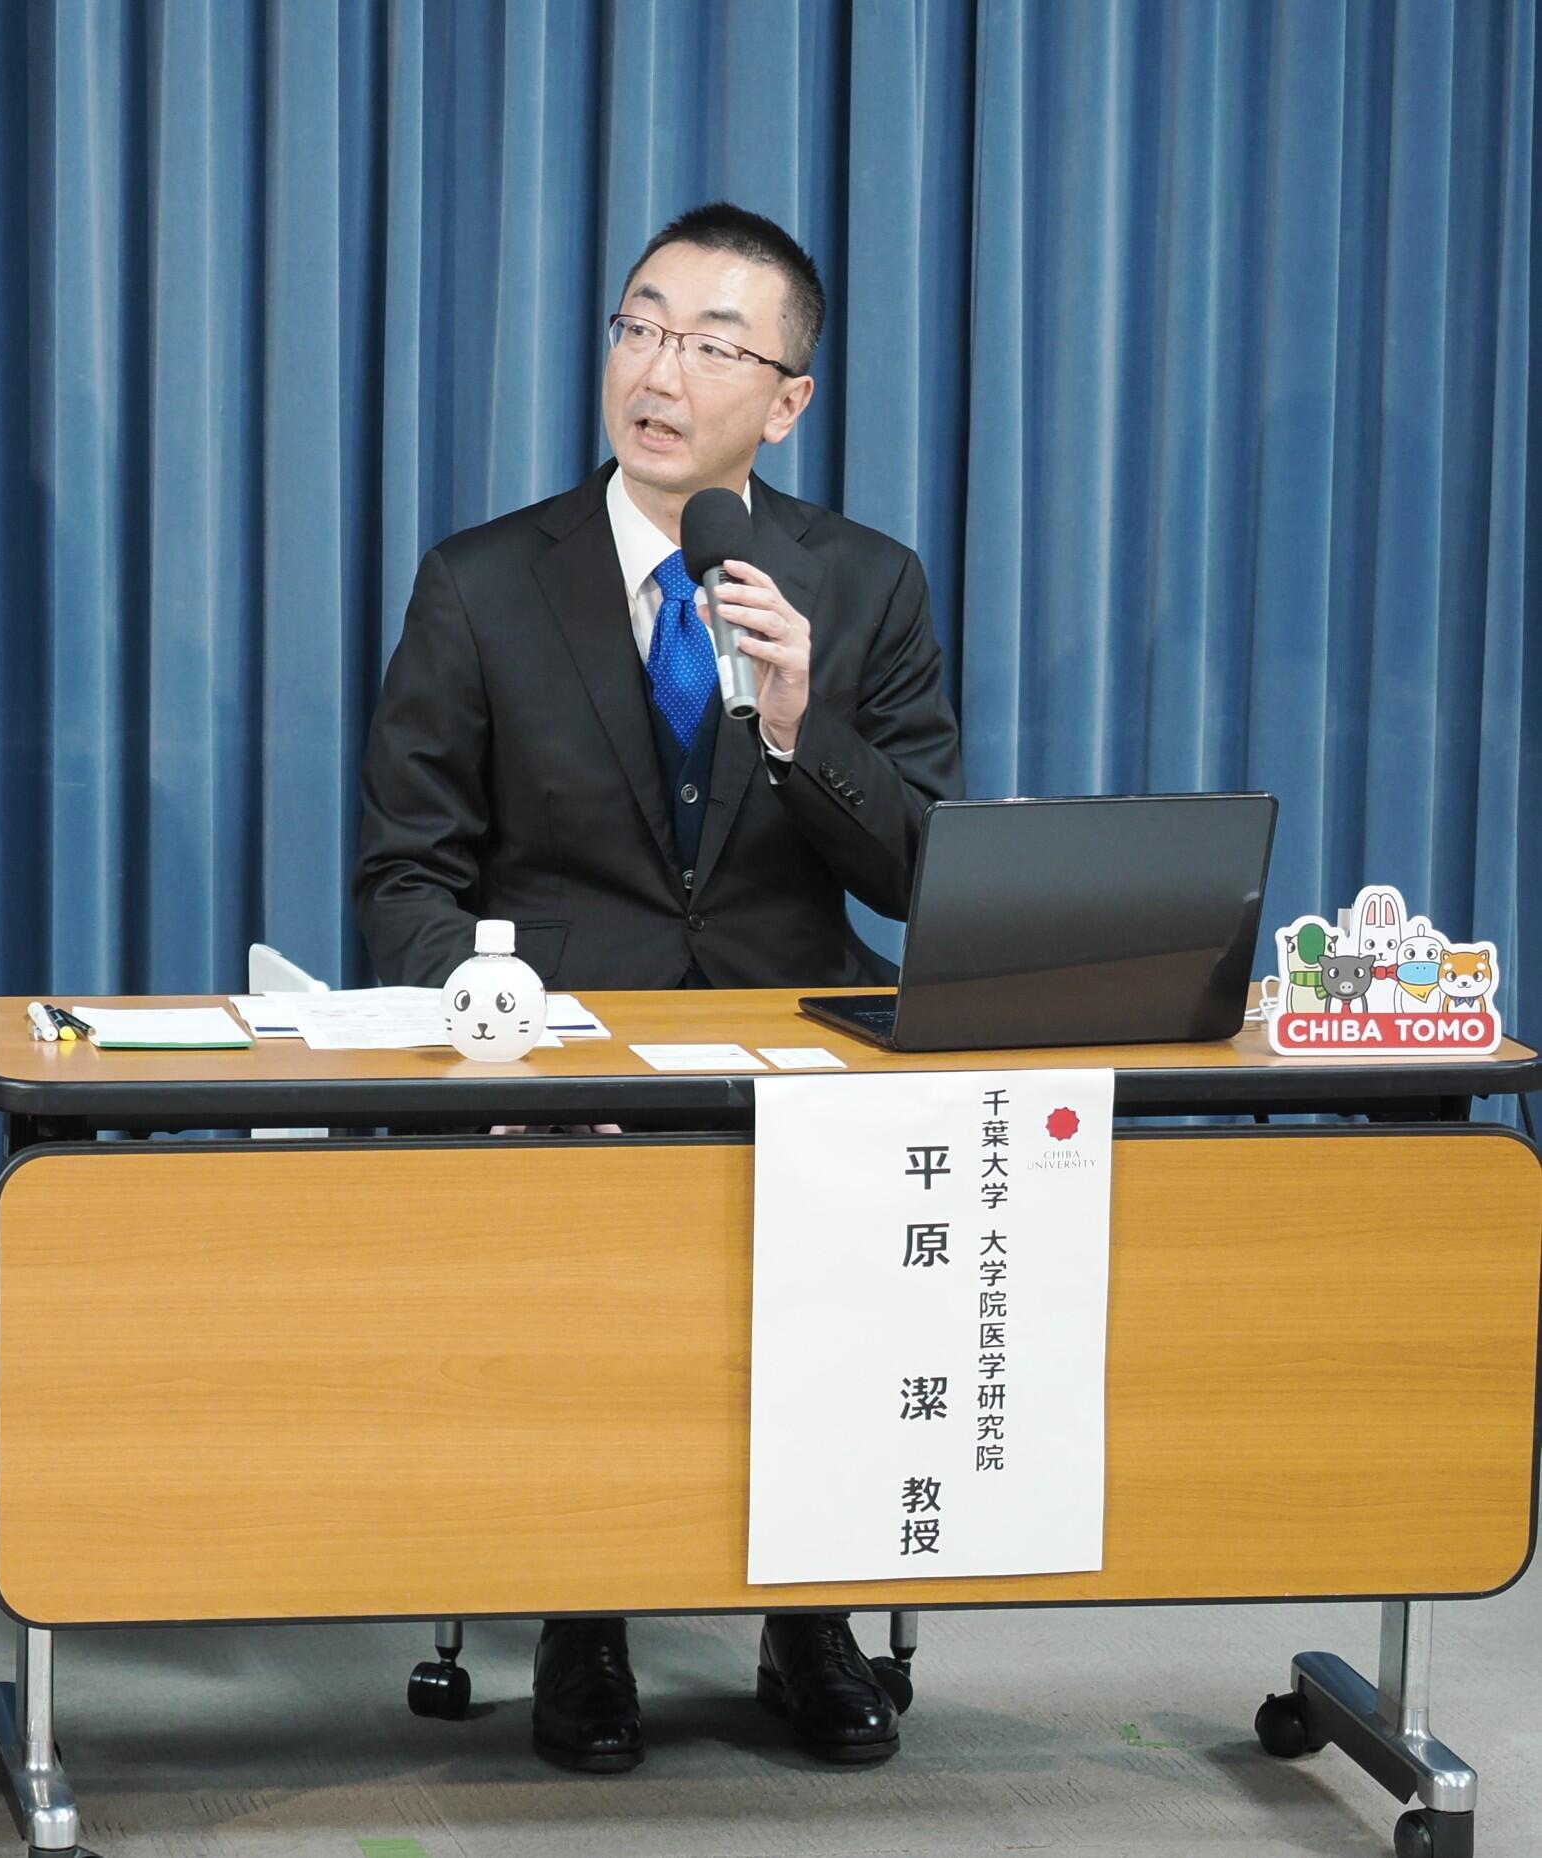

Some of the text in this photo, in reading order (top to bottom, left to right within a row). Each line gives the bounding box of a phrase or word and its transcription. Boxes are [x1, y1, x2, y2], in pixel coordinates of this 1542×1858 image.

[1287, 1018, 1485, 1042] CHIBA TOMO
[1027, 1160, 1097, 1170] UNIVERSITY
[1043, 1149, 1081, 1160] CHIBA
[976, 1088, 1010, 1472] 千葉大学 大学院医学研究院
[899, 1376, 948, 1421] 潔
[900, 1476, 942, 1556] 教授
